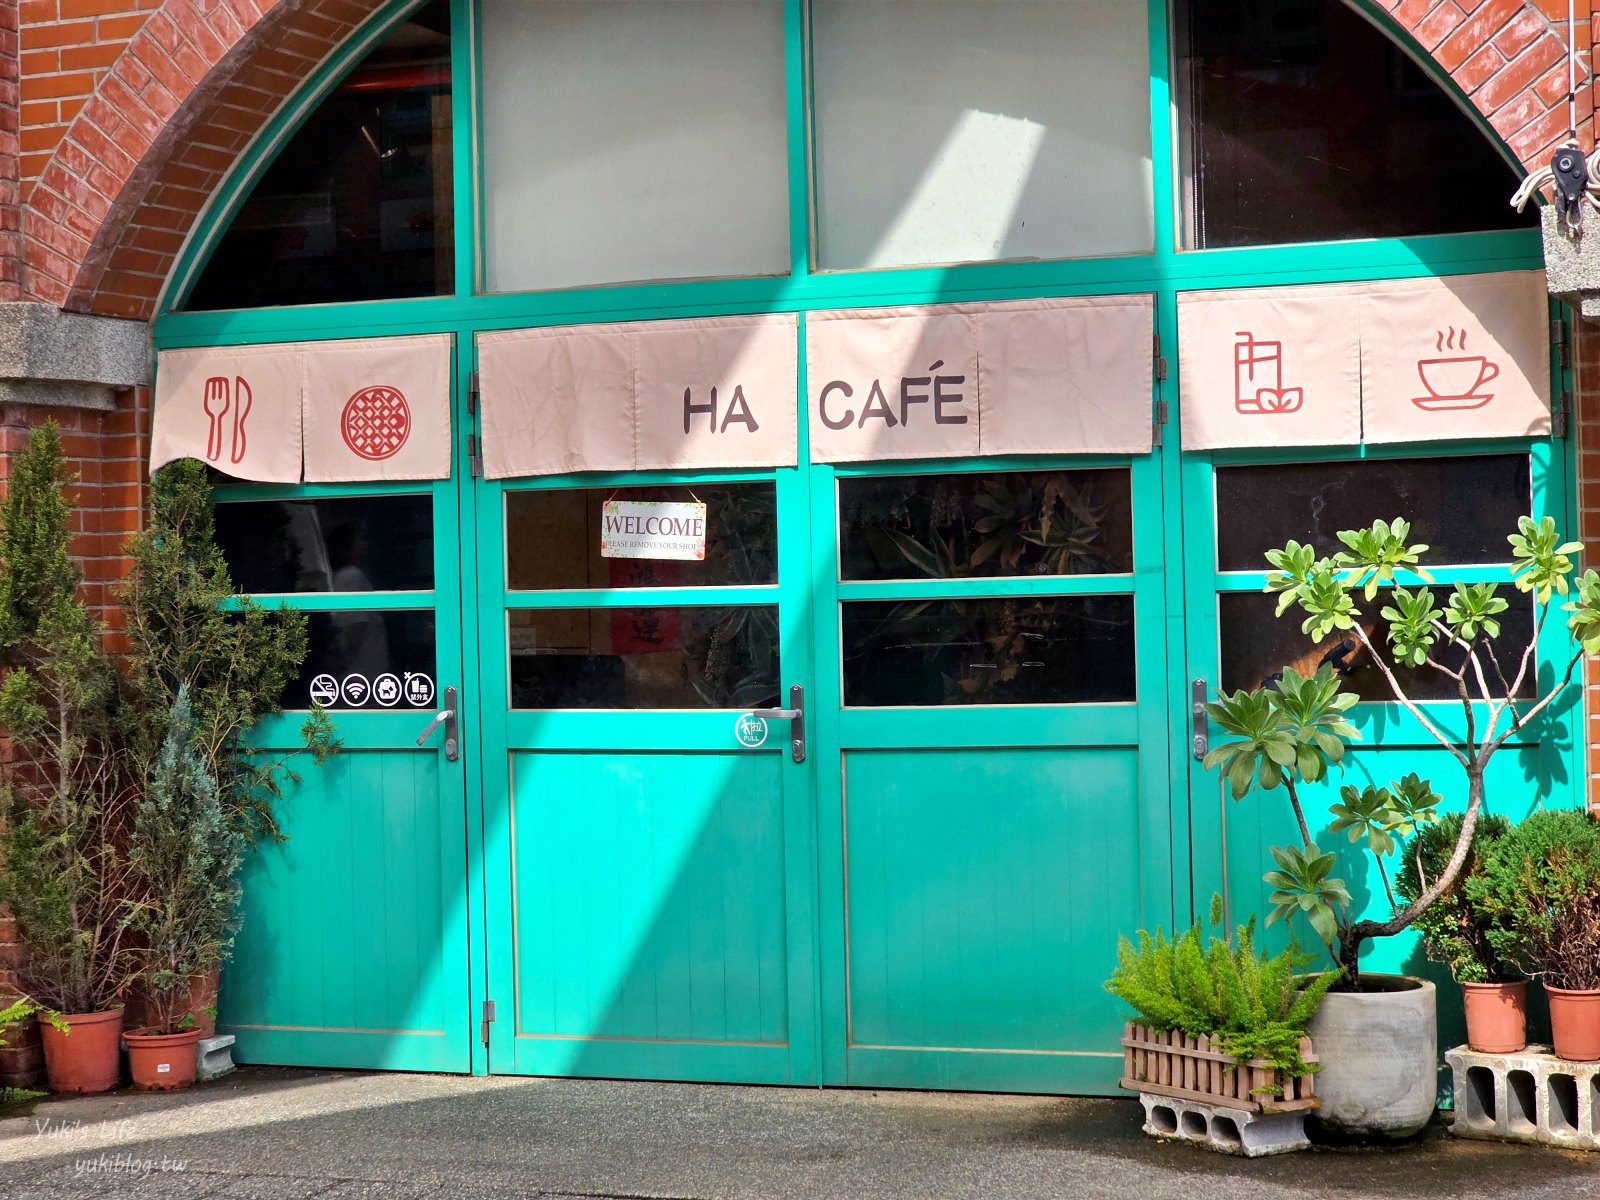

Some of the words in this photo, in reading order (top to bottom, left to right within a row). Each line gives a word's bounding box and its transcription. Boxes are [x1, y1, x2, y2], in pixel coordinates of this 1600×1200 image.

[683, 384, 760, 434] HA
[819, 359, 968, 431] CAFÉ
[605, 515, 703, 537] WELCOME
[630, 541, 658, 549] REMOVE
[659, 542, 678, 550] YOUR
